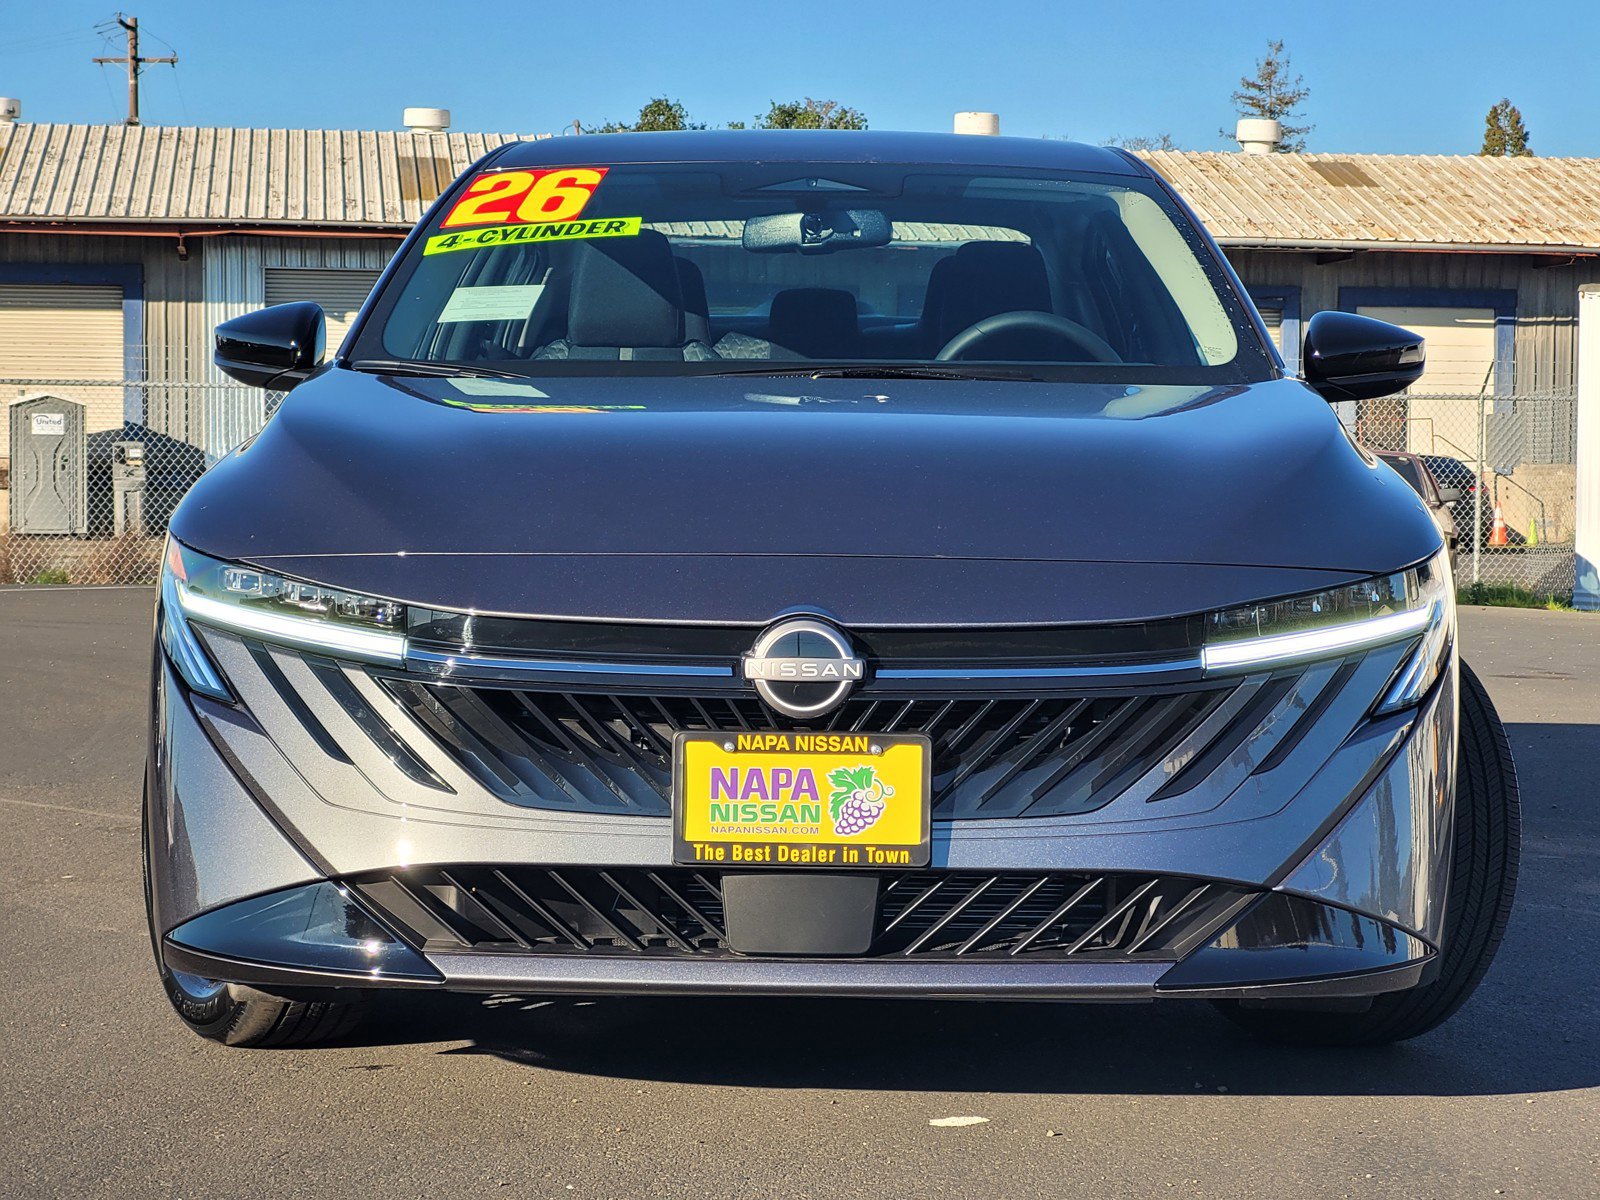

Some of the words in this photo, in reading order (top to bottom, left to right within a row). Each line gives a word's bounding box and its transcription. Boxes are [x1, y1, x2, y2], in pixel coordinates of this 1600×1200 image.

[445, 169, 602, 226] 26
[436, 220, 630, 249] 4-CYLINDER
[748, 662, 861, 677] NISSAN
[737, 734, 790, 751] NAPA
[795, 735, 868, 752] NISSAN
[710, 767, 819, 800] NAPA
[710, 804, 820, 823] NISSAN
[711, 826, 819, 834] NAPANISSAN.COM
[693, 843, 725, 861] The
[732, 844, 771, 862] Best
[778, 845, 836, 863] Dealer
[843, 845, 859, 862] in
[866, 846, 910, 864] Town
